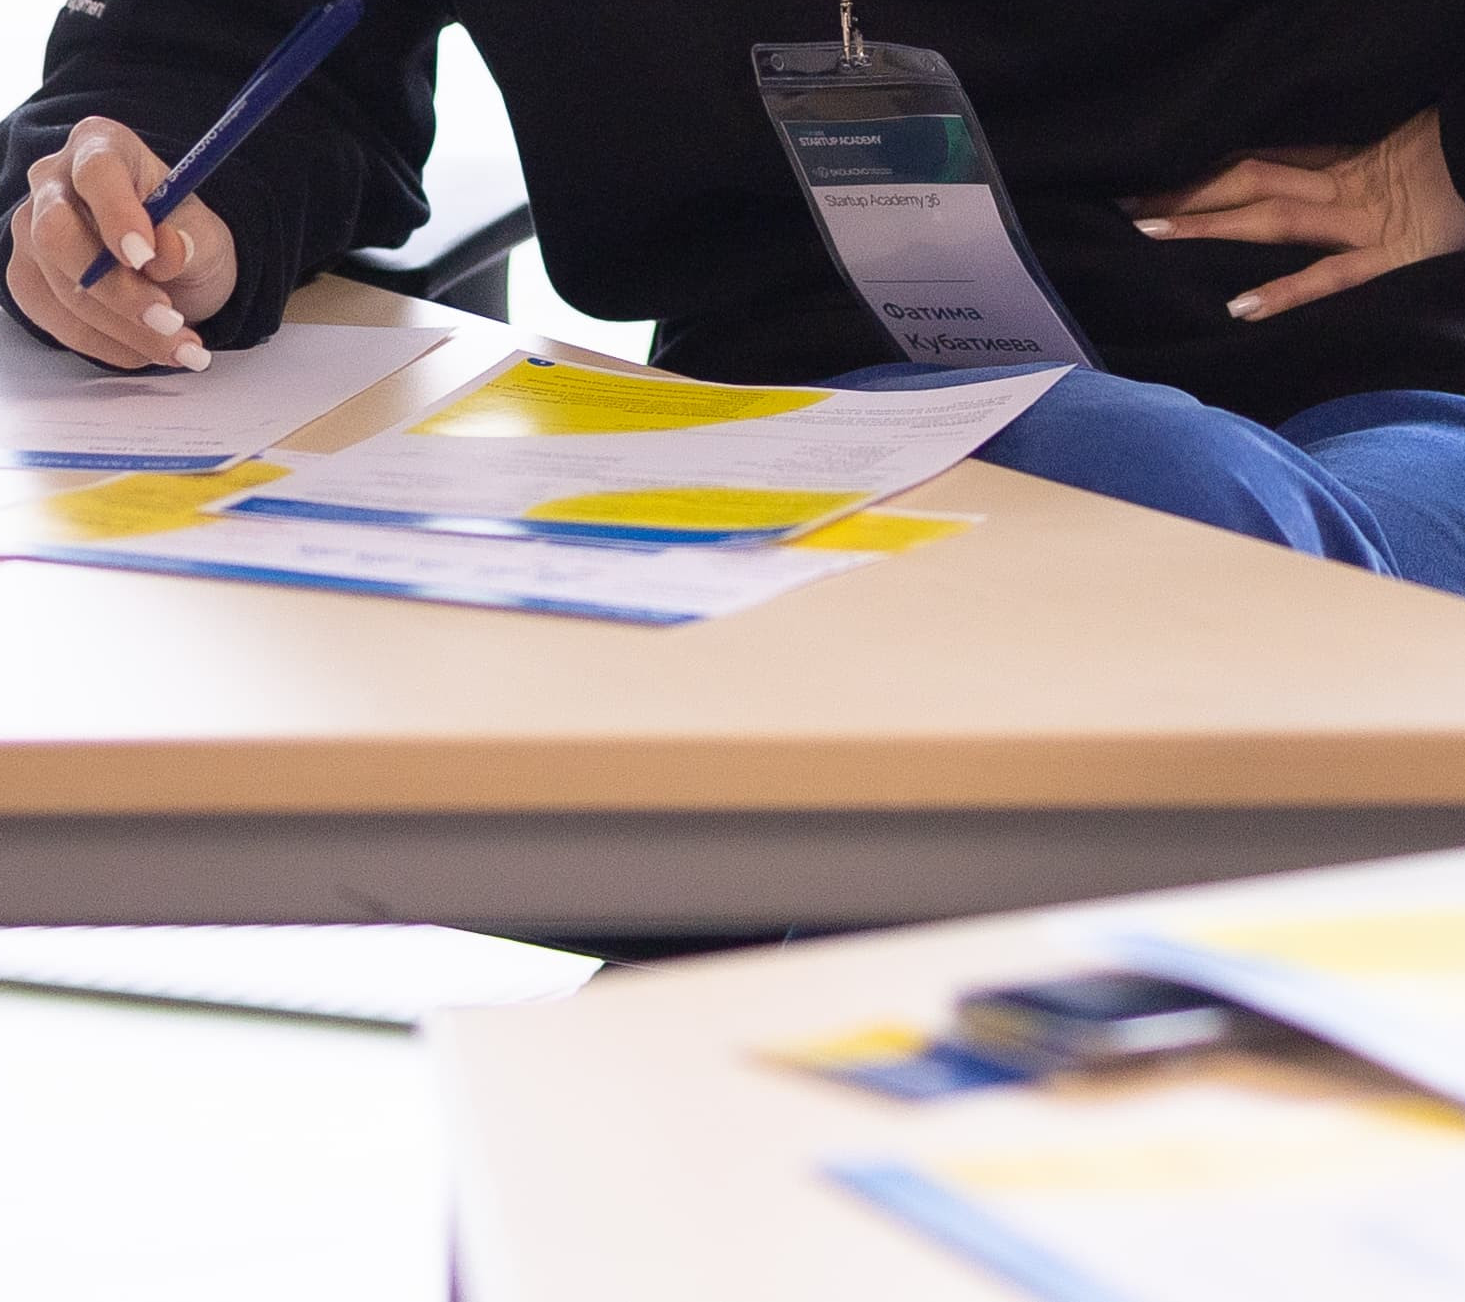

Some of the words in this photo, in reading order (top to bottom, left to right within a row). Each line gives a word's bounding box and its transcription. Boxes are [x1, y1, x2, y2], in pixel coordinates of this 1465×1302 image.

[824, 194, 868, 208] Startup
[870, 193, 924, 208] Academy
[882, 302, 984, 321] Фатима
[903, 333, 1044, 354] Кубатиева
